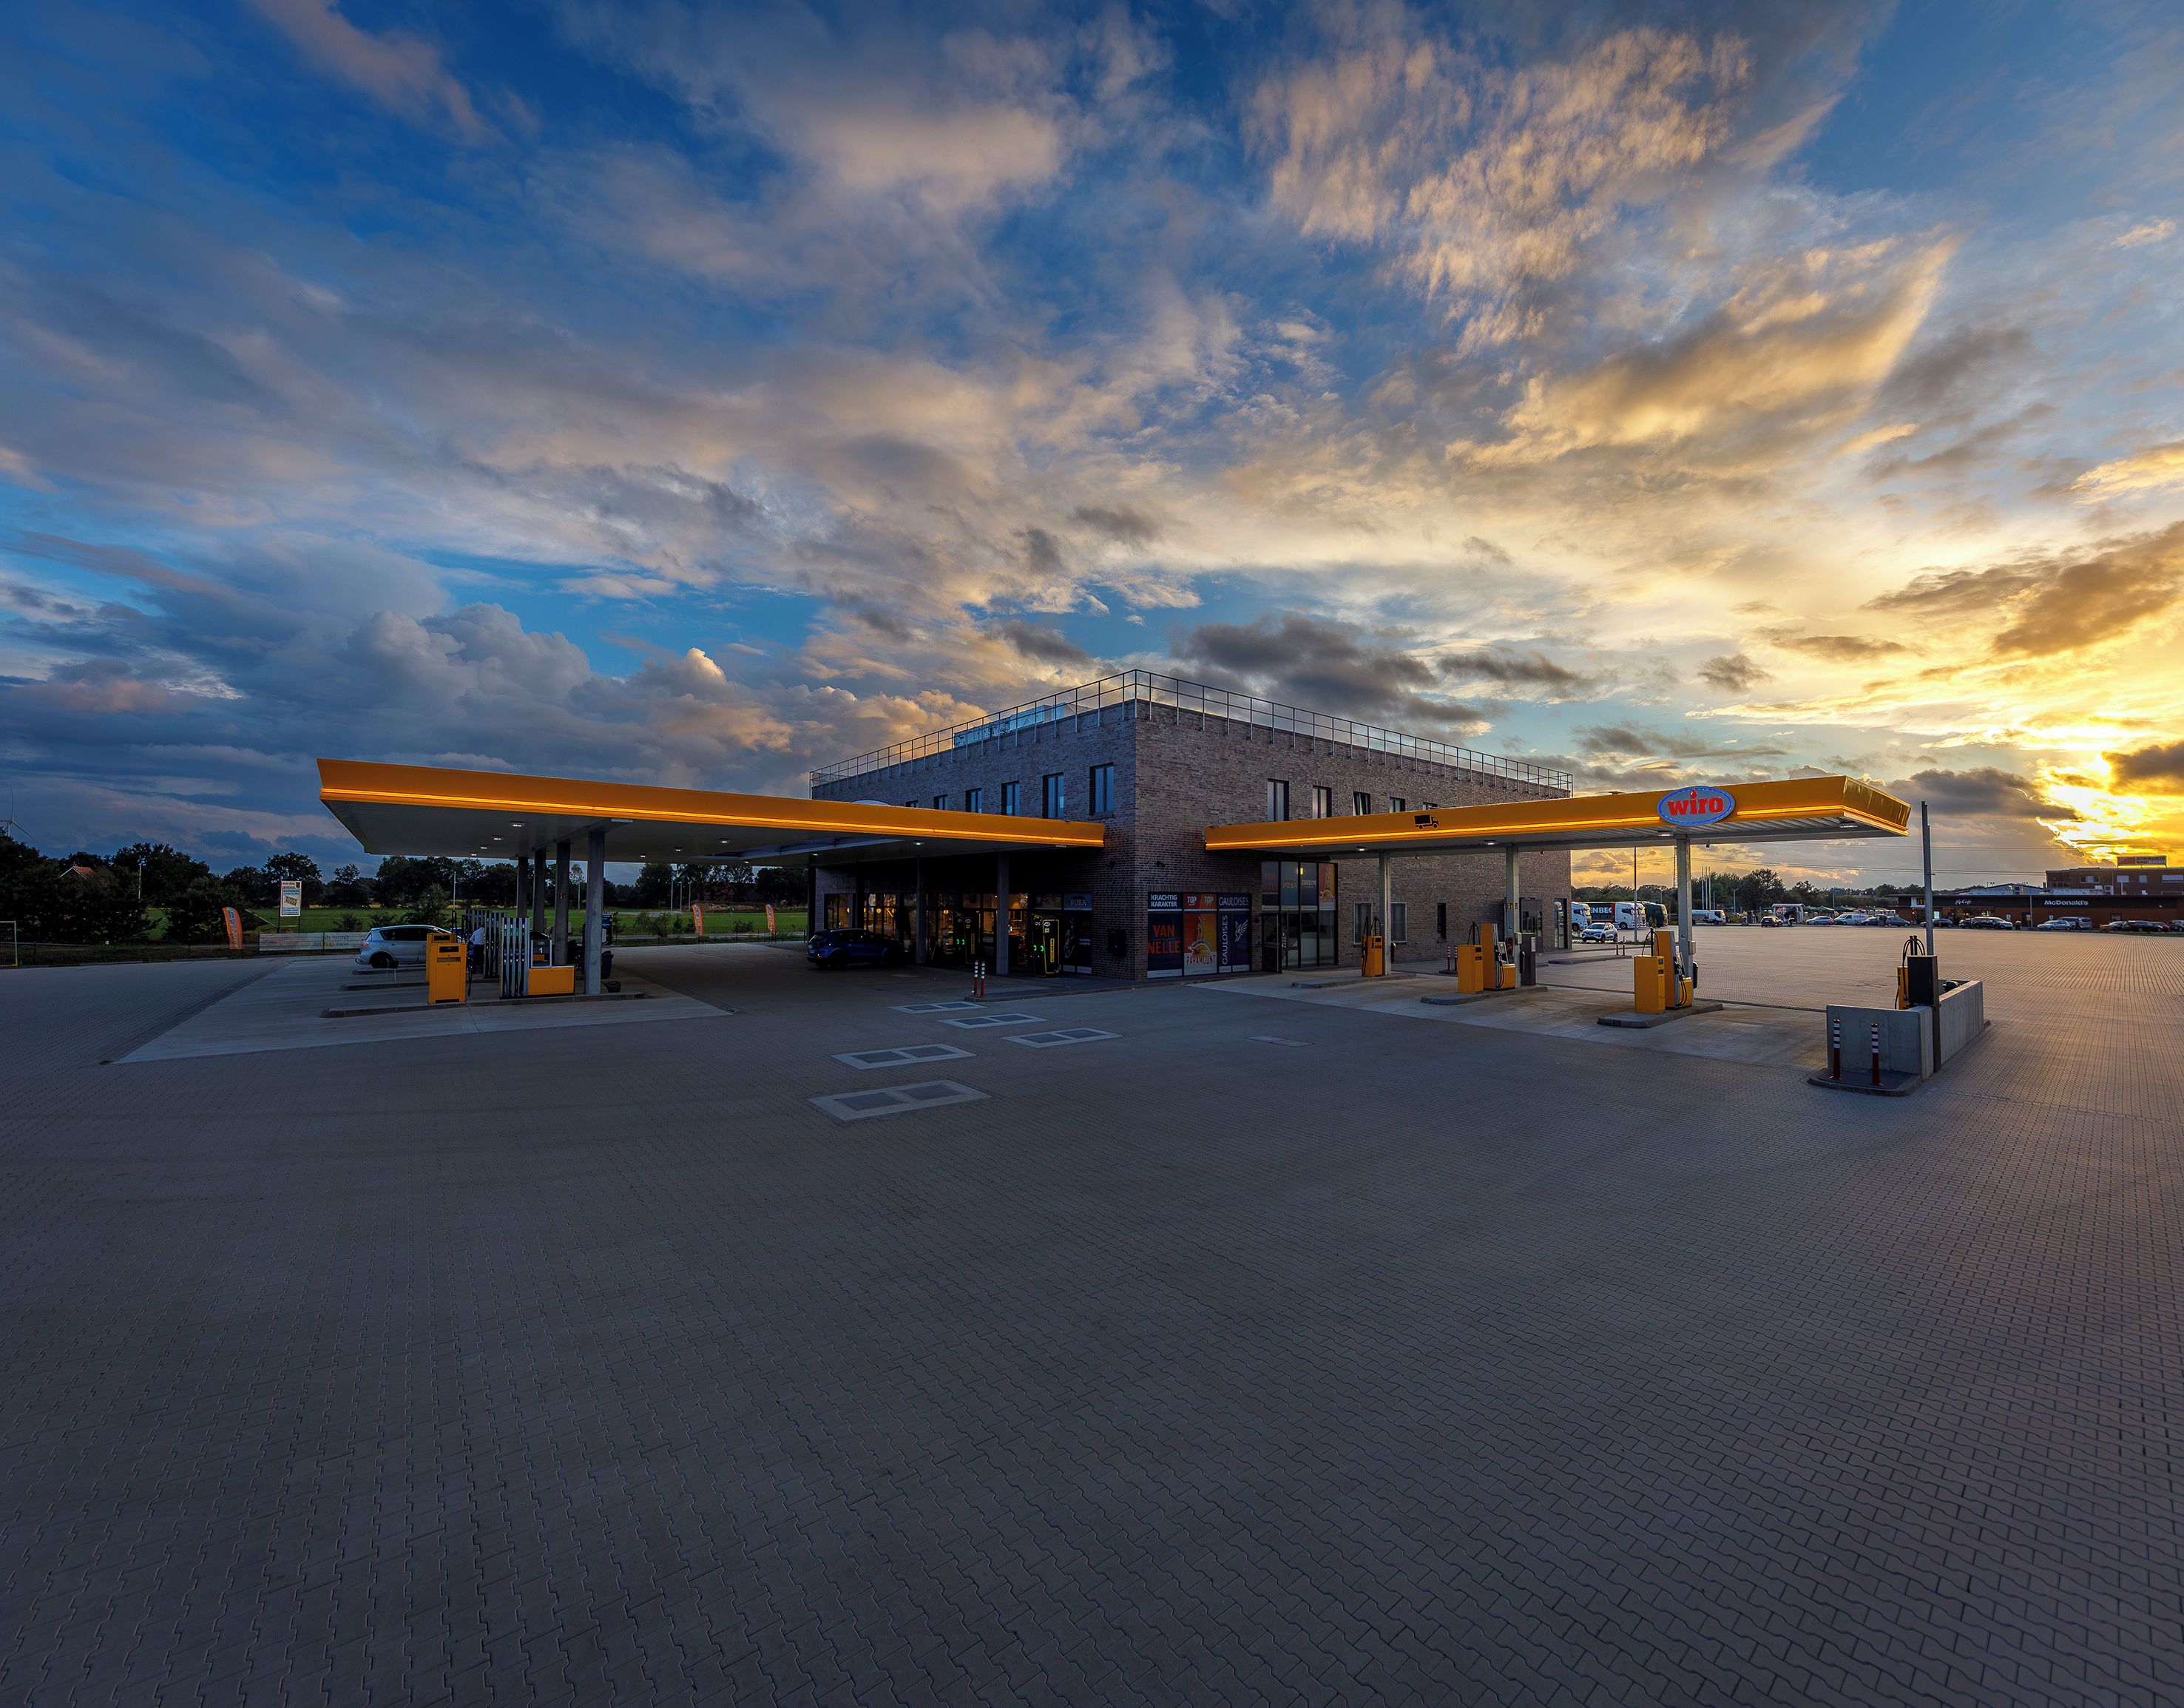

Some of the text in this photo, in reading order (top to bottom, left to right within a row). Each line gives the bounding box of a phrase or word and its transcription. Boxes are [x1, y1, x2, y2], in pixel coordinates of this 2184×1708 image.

[1667, 789, 1723, 816] wiro
[1186, 896, 1197, 904] TOP
[1203, 896, 1214, 904] TOP
[1218, 897, 1249, 907] GAULOISES
[1152, 923, 1176, 938] VAN
[1148, 940, 1181, 955] NELLE
[1186, 955, 1216, 965] PARAMOUNT
